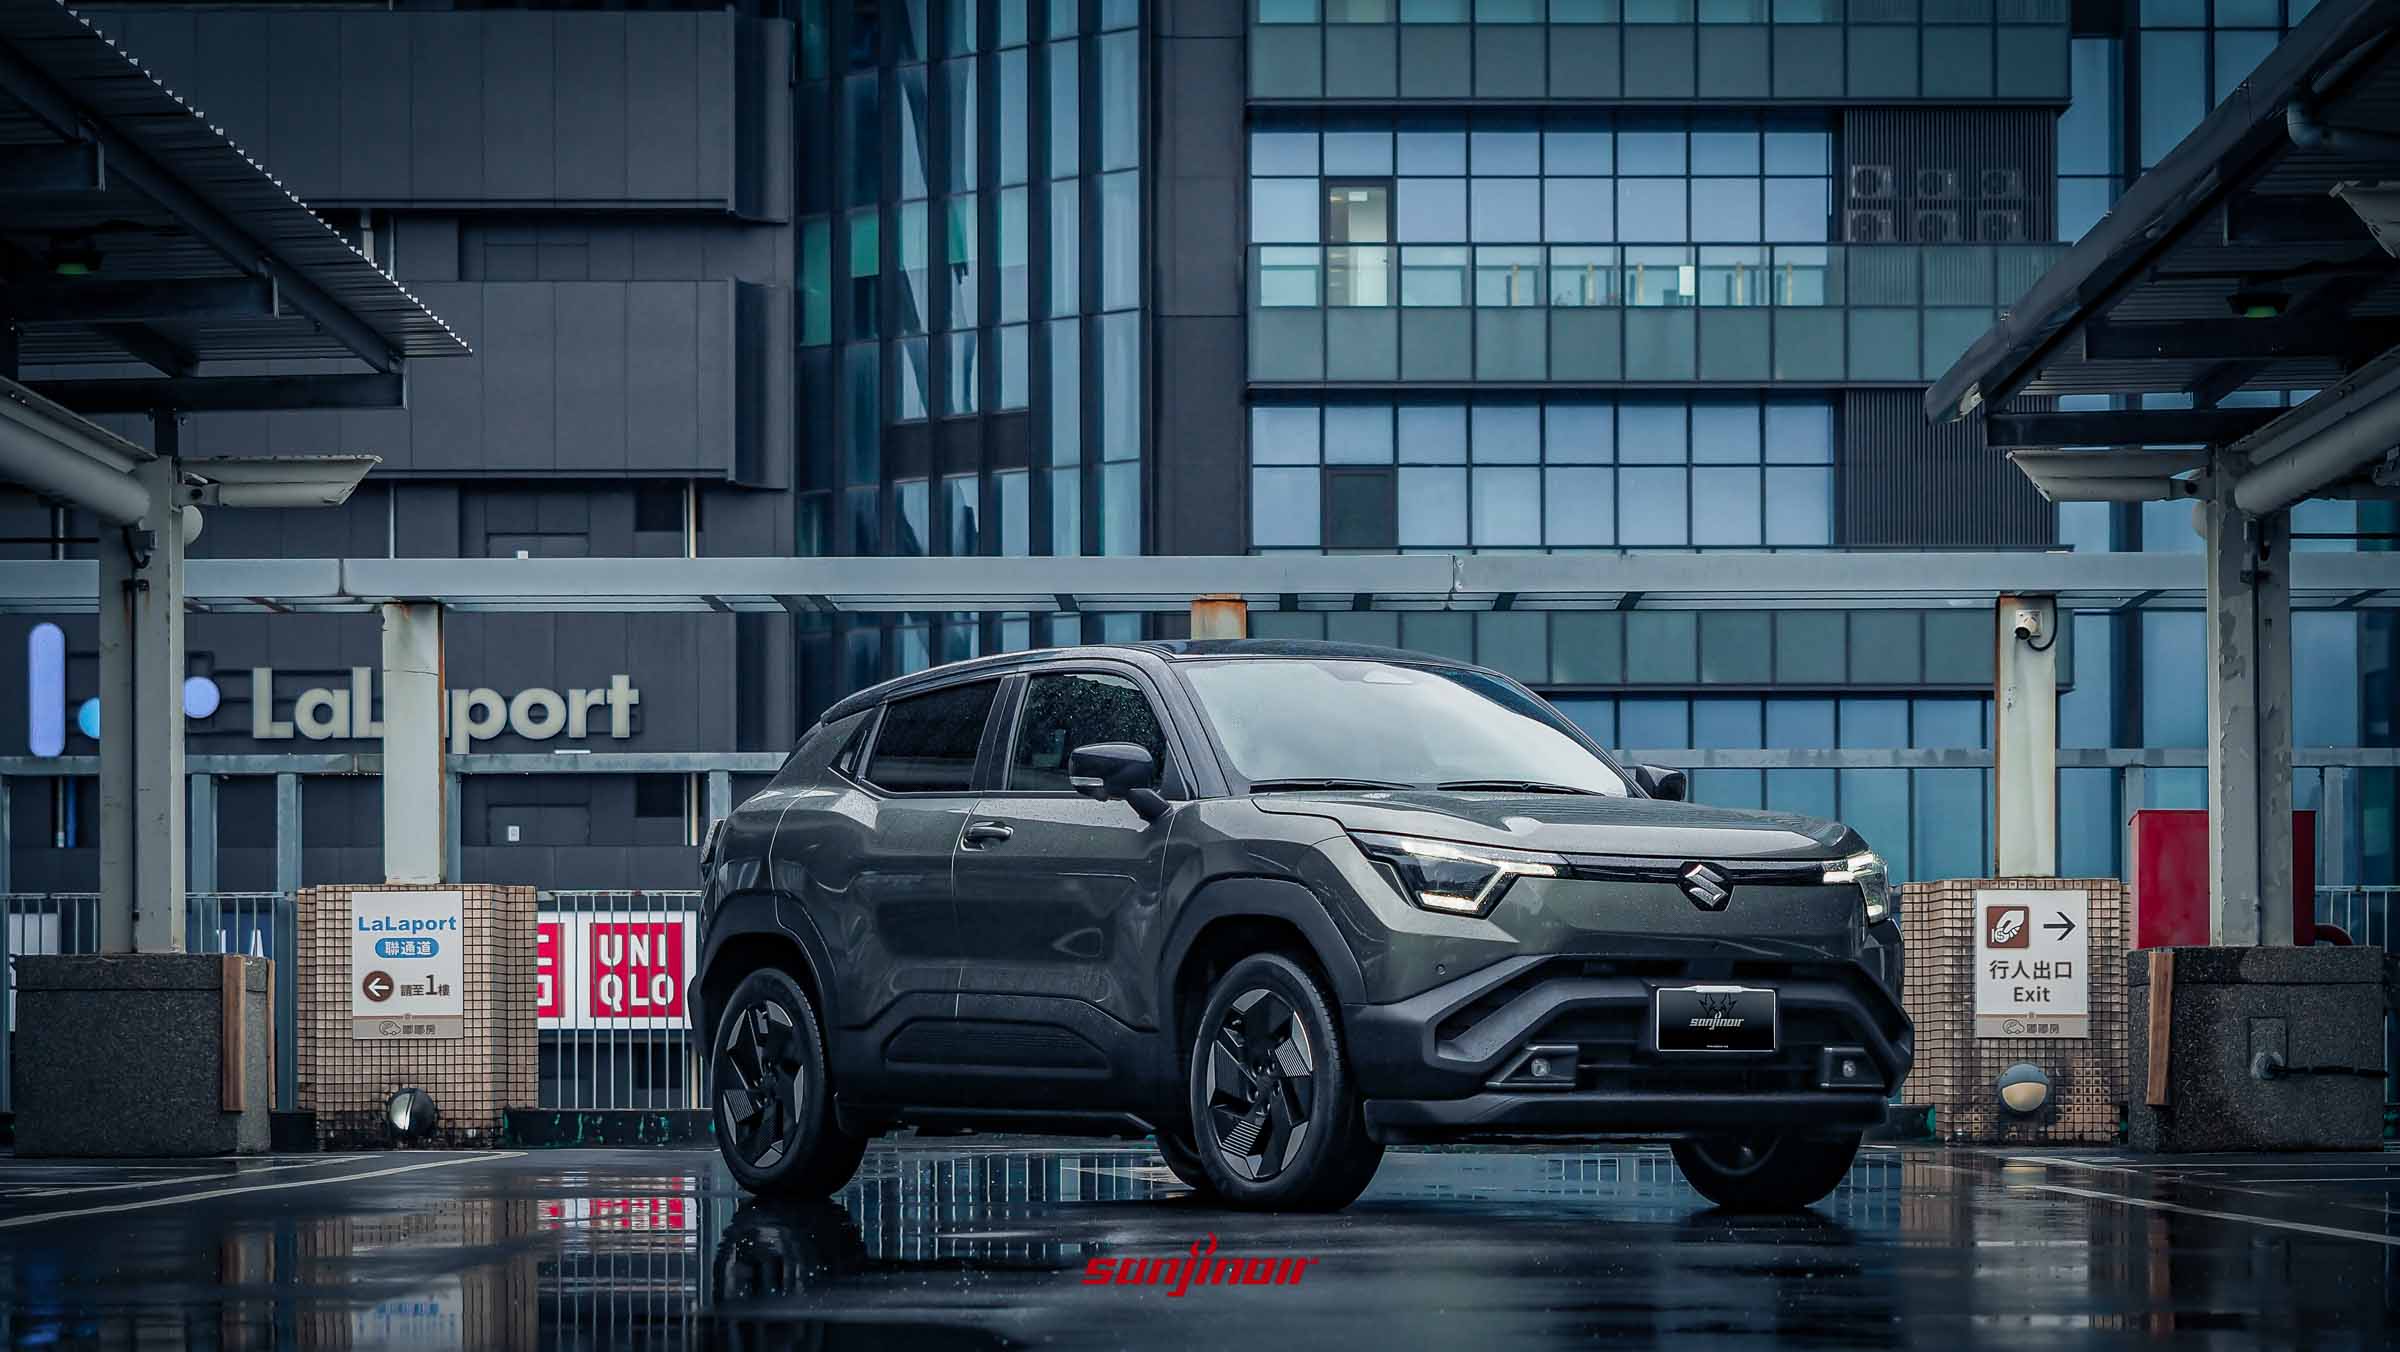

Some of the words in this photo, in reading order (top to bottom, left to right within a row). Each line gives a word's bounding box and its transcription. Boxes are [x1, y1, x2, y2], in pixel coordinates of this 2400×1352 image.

[252, 666, 640, 755] LaLport
[358, 915, 457, 935] LaLaport
[599, 934, 667, 967] UNI
[1989, 959, 2073, 980] 行人出口
[600, 974, 675, 1013] QLO
[2013, 986, 2051, 1003] Exit
